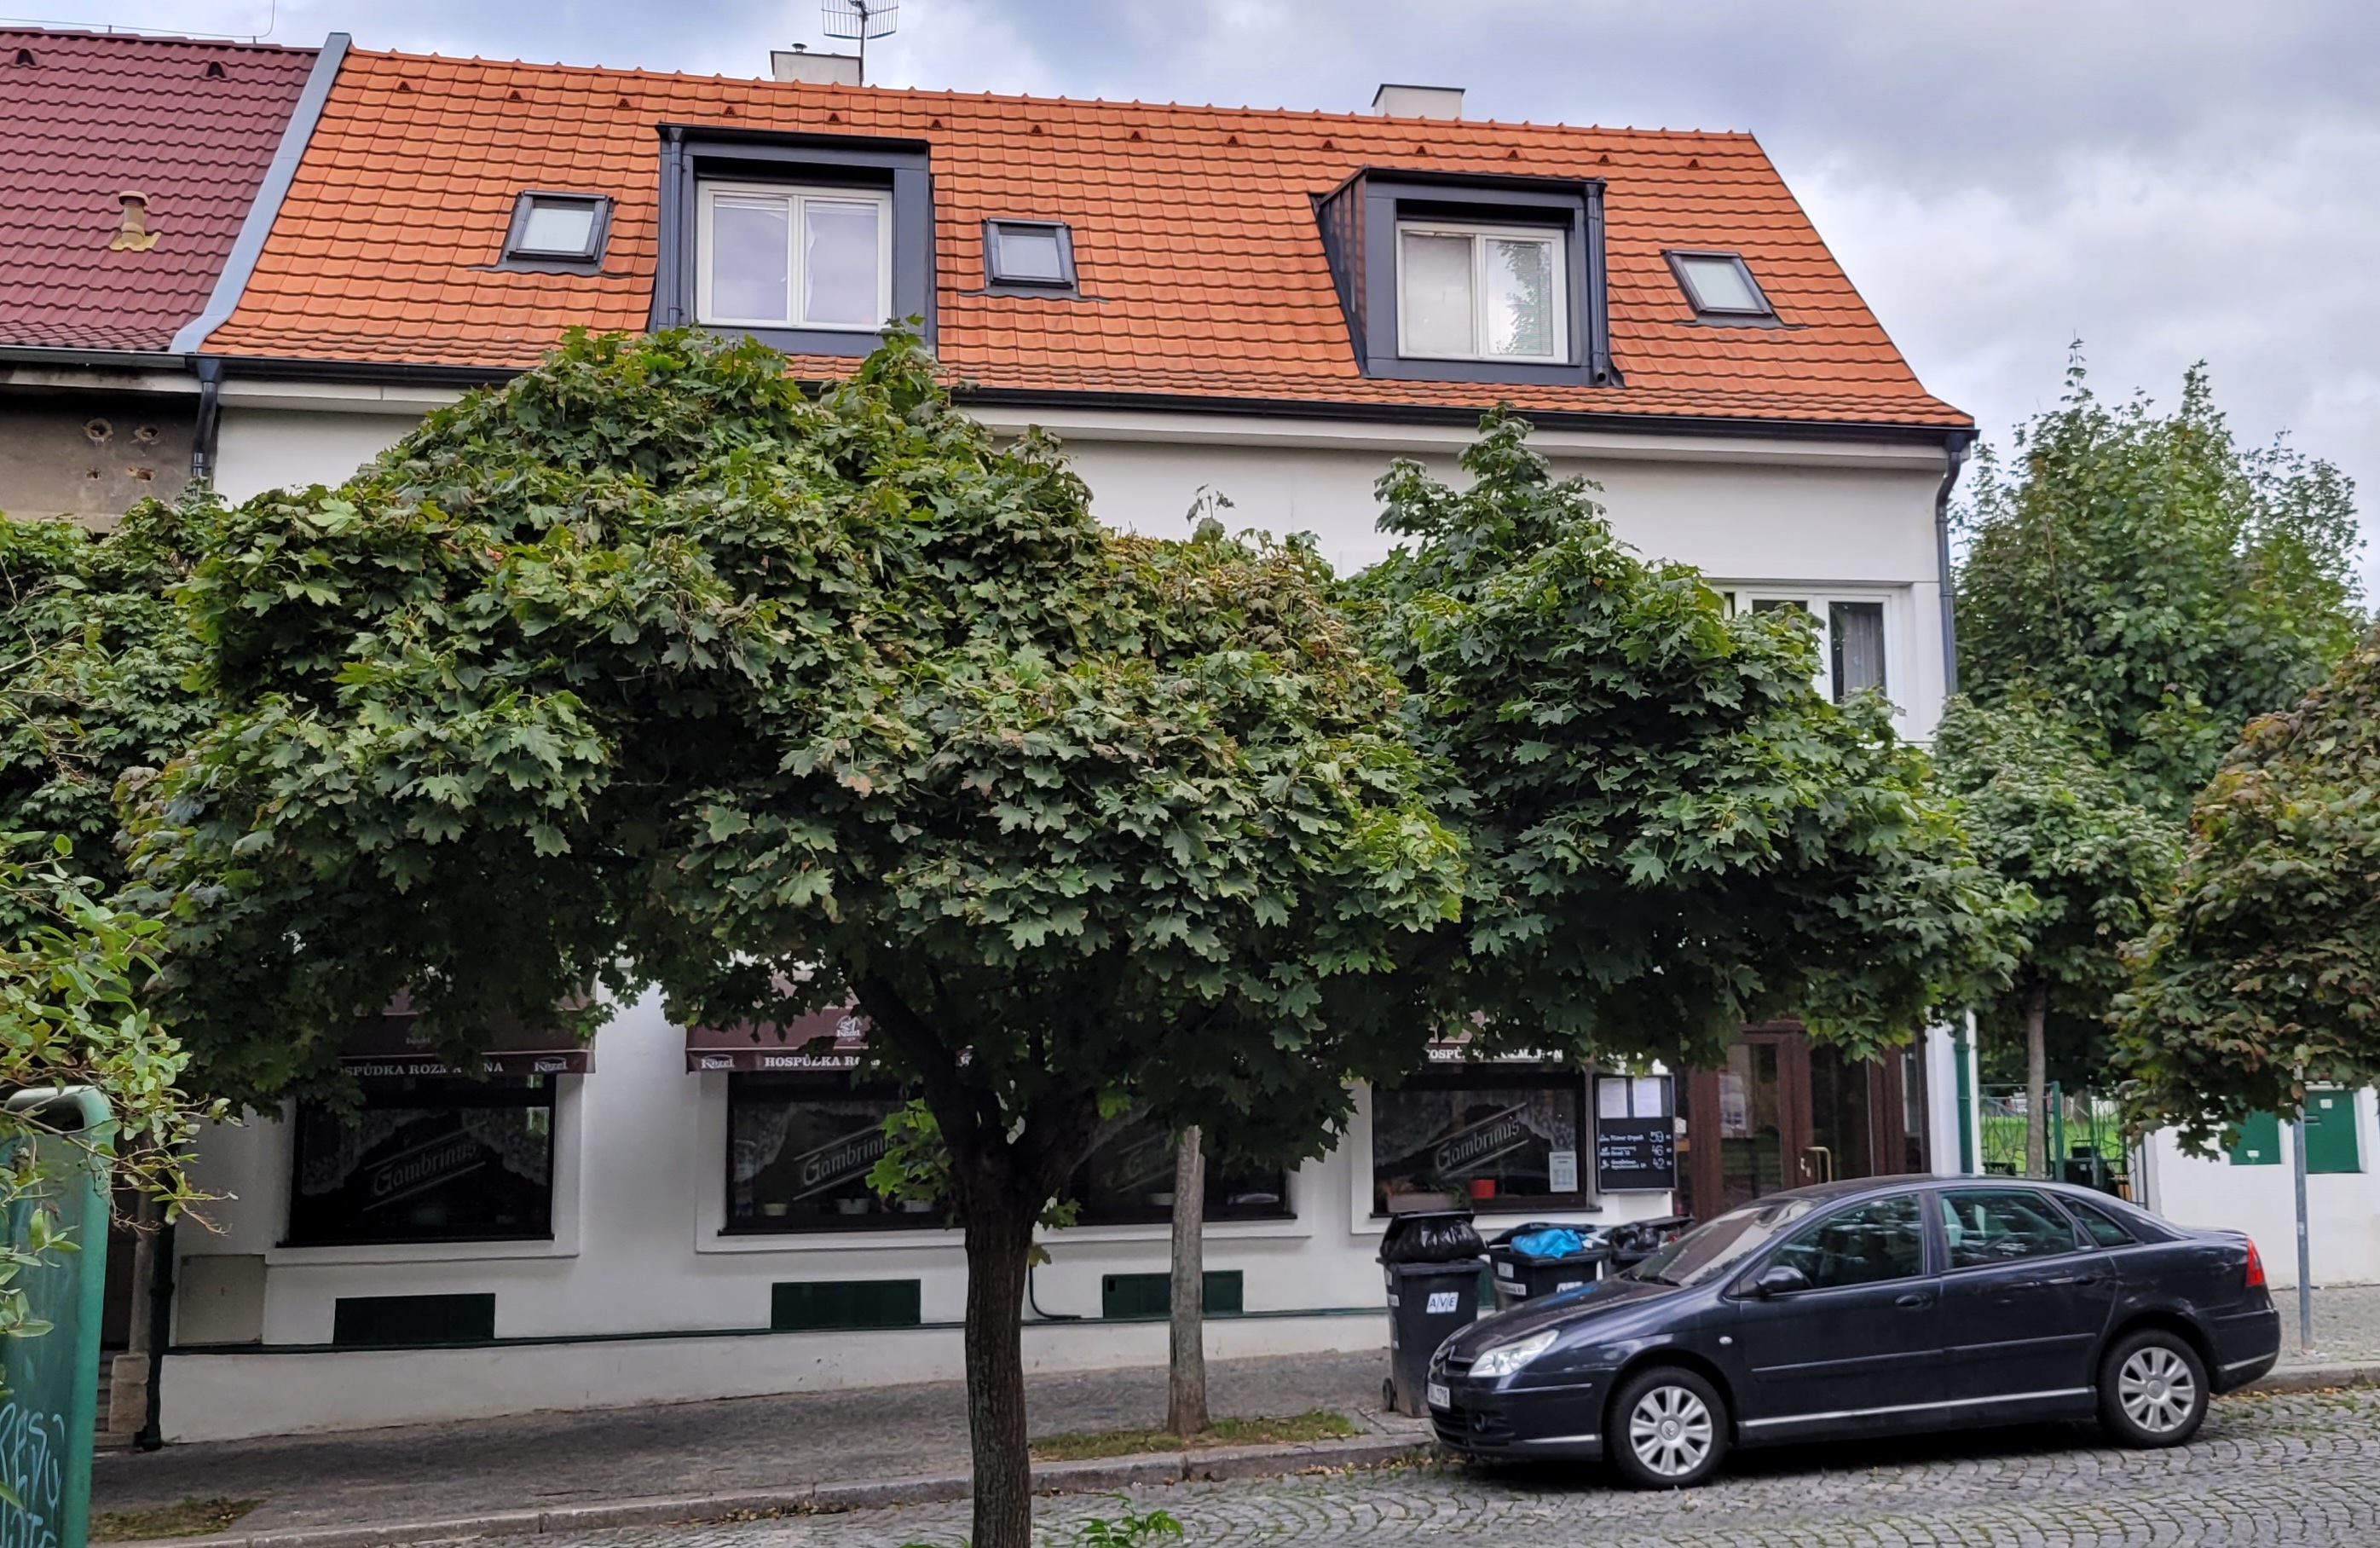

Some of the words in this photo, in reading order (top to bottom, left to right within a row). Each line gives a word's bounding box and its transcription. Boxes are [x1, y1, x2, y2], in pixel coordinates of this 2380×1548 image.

[701, 1059, 735, 1069] Kozel
[1436, 1118, 1521, 1171] Gambrinus
[1651, 1145, 1665, 1156] 46
[373, 1140, 479, 1196] Gambrinus
[1652, 1158, 1667, 1170] 42
[1429, 1297, 1456, 1308] AVE
